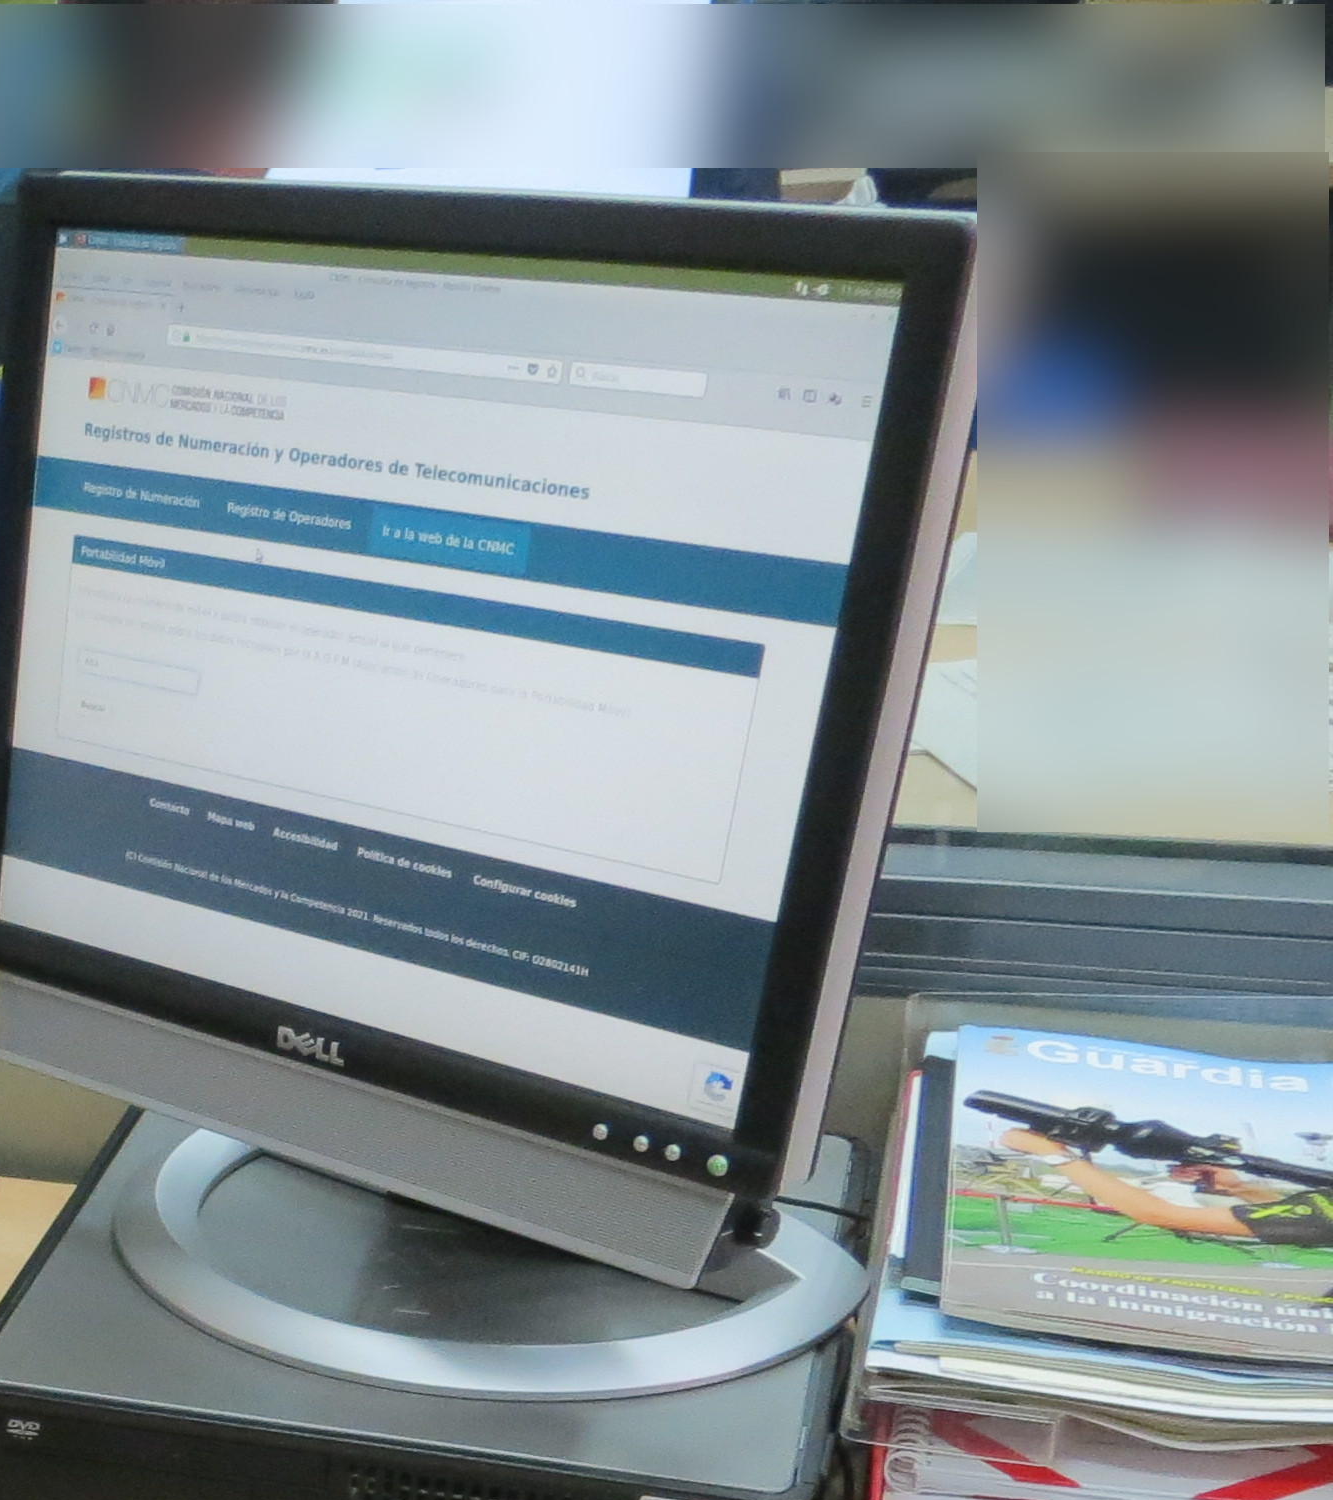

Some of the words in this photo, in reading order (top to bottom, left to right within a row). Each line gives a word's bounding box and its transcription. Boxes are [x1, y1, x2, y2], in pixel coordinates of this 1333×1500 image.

[231, 404, 285, 421] COMPETENCIA
[84, 422, 150, 446] Registros
[155, 431, 174, 447] de
[178, 433, 269, 459] Numeración
[274, 448, 284, 463] y
[288, 447, 383, 474] Operadores
[388, 458, 409, 475] de
[415, 463, 590, 499] Telecomunicaciones
[83, 482, 123, 499] Registro
[126, 487, 137, 499] de
[140, 489, 200, 508] Numeración
[226, 502, 270, 520] Registro
[273, 508, 286, 521] de
[289, 510, 352, 531] Operadores
[382, 525, 390, 537] Ir
[404, 527, 415, 541] la
[418, 531, 442, 545] web
[445, 534, 460, 548] de
[462, 536, 474, 550] la
[477, 539, 515, 556] CNMC
[81, 546, 137, 565] Portabilidad
[139, 554, 166, 569] Móvil
[149, 798, 190, 816] Contacto
[207, 811, 233, 827] Mapa
[235, 818, 255, 831] web
[272, 827, 338, 851] Accesibilidad
[357, 846, 395, 866] Política
[397, 856, 410, 868] de
[413, 861, 453, 879] cookies
[137, 854, 173, 870] Comisión
[174, 862, 208, 879] Nacional
[209, 872, 220, 883] de
[220, 874, 233, 886] los
[234, 878, 272, 896] Mercados
[290, 892, 345, 915] Competencia
[373, 914, 423, 935] Reservados
[425, 927, 449, 942] todos
[450, 933, 464, 945] los
[473, 874, 532, 898] Configurar
[534, 889, 577, 908] cookies
[276, 1025, 345, 1067] DELL
[1027, 1040, 1309, 1093] Guardia
[1033, 1272, 1263, 1313] Coordinación
[1036, 1290, 1054, 1301] a
[1066, 1291, 1097, 1306] la
[1108, 1295, 1318, 1334] inmigración
[7, 1419, 41, 1431] DVD
